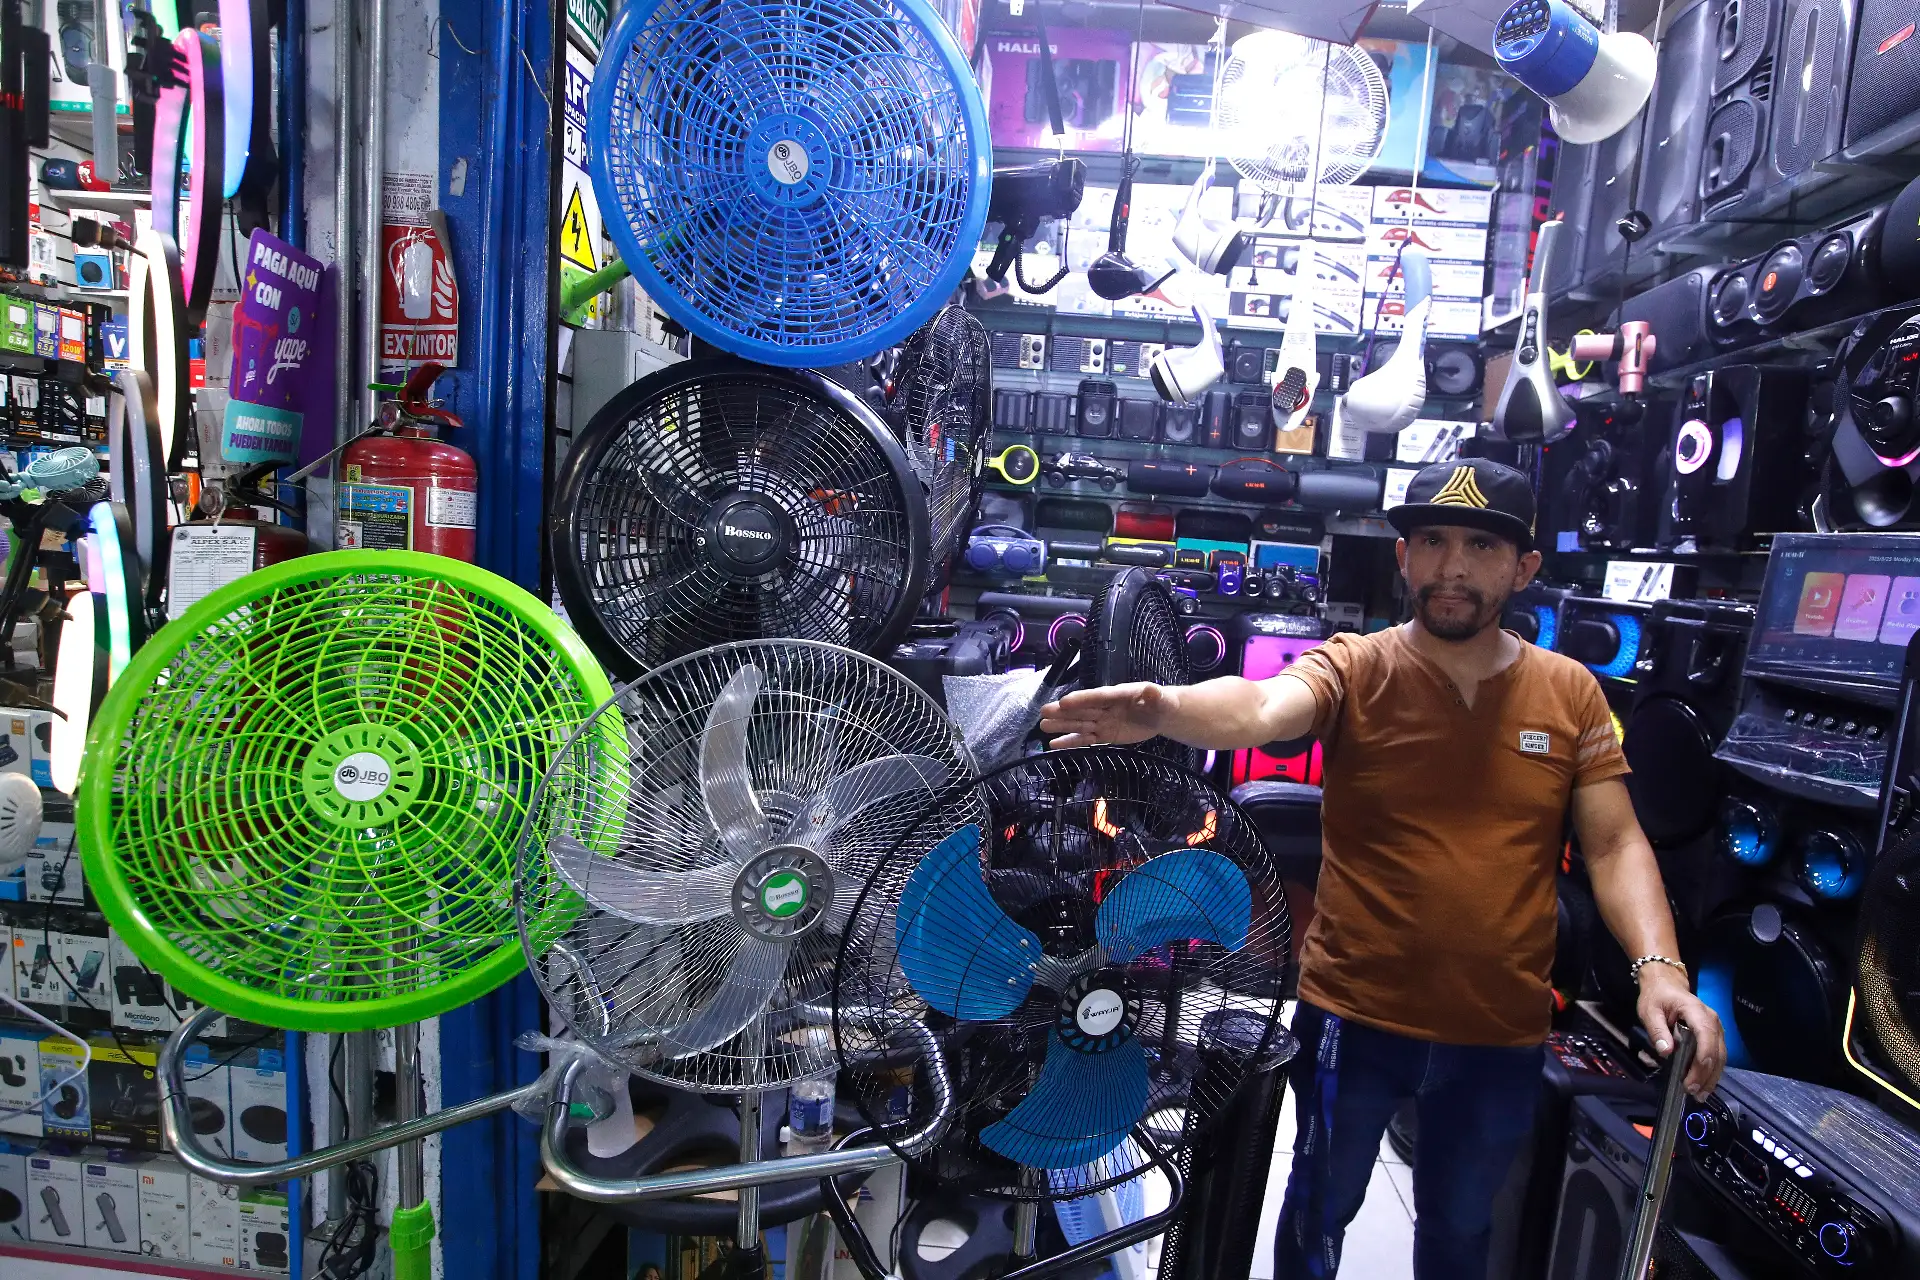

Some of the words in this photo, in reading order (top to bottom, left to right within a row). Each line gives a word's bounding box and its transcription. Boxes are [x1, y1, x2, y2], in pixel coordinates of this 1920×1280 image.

[784, 159, 802, 180] JBO
[254, 242, 287, 278] PAGA
[288, 262, 319, 293] AQUÍ
[256, 281, 282, 311] CON
[384, 333, 455, 356] EXTINTOR
[266, 337, 307, 385] yape
[236, 415, 265, 432] AHORA
[266, 419, 293, 437] TODOS
[229, 433, 263, 450] PUEDEN
[359, 770, 389, 782] JBO
[142, 1175, 154, 1185] mi
